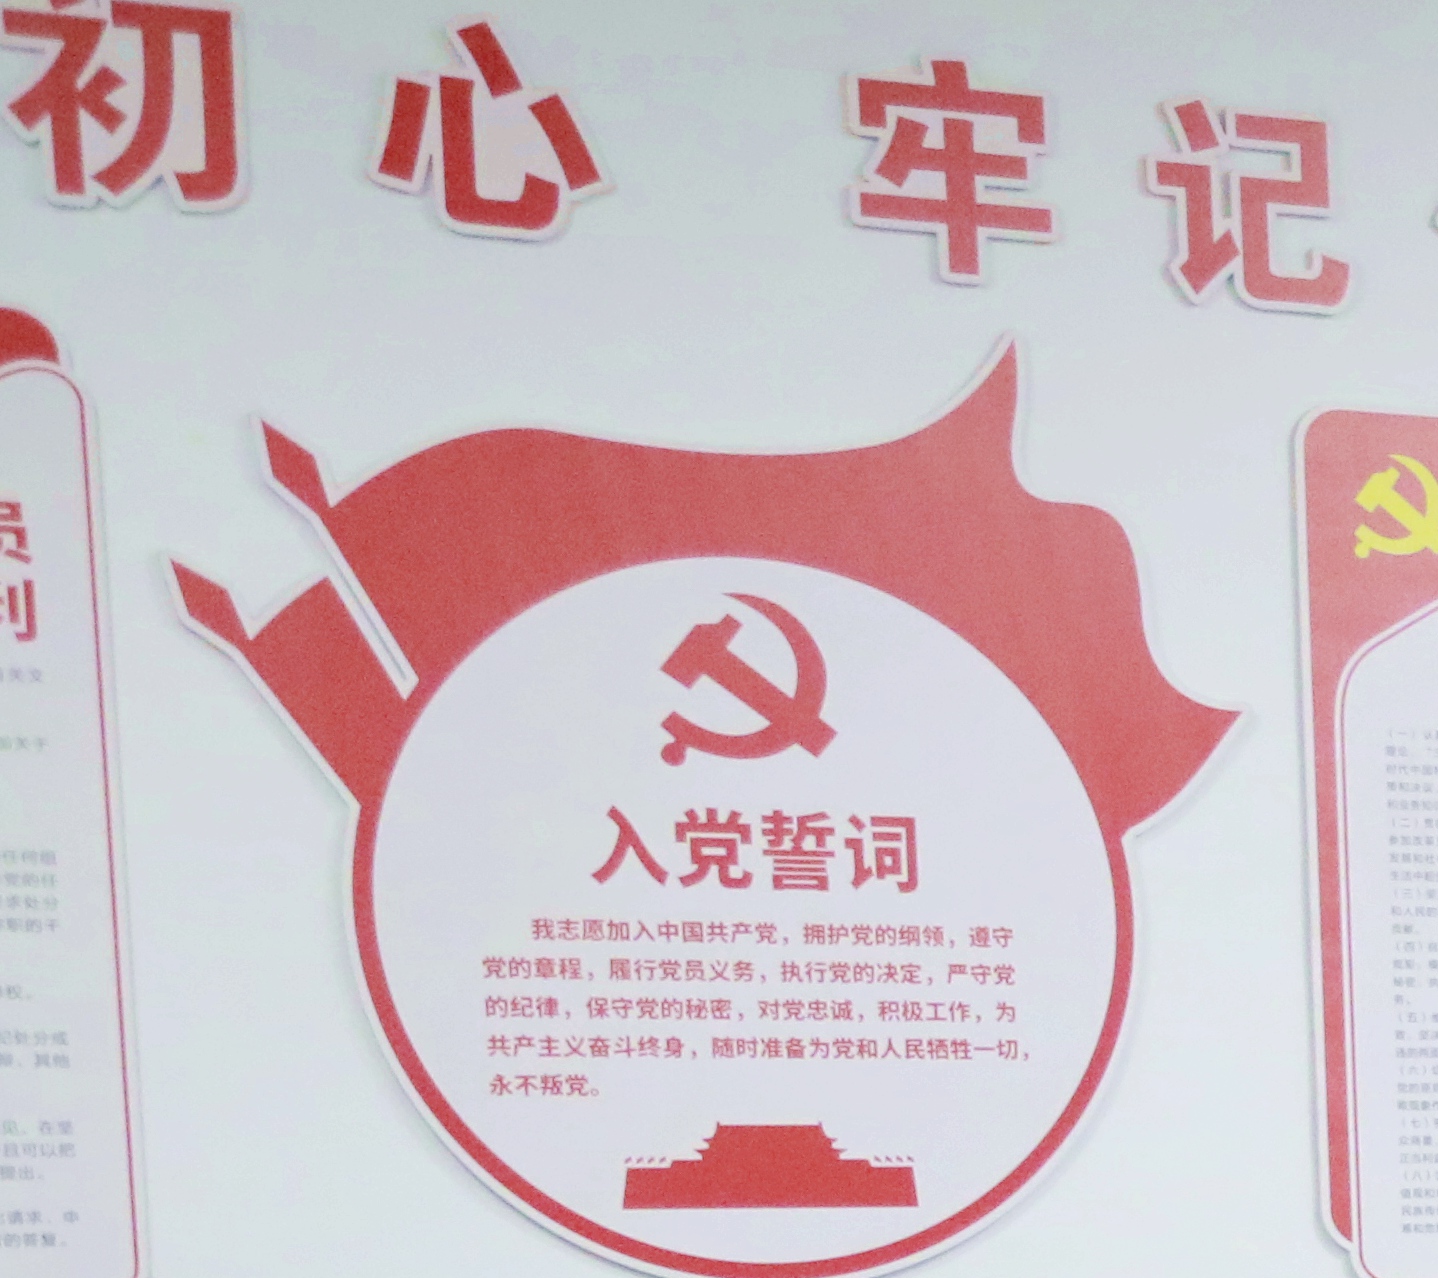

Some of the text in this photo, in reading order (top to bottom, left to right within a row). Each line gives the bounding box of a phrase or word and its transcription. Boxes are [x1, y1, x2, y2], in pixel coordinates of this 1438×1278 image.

[591, 805, 919, 893] 入党誓词
[489, 1073, 600, 1097] 永不叛党。
